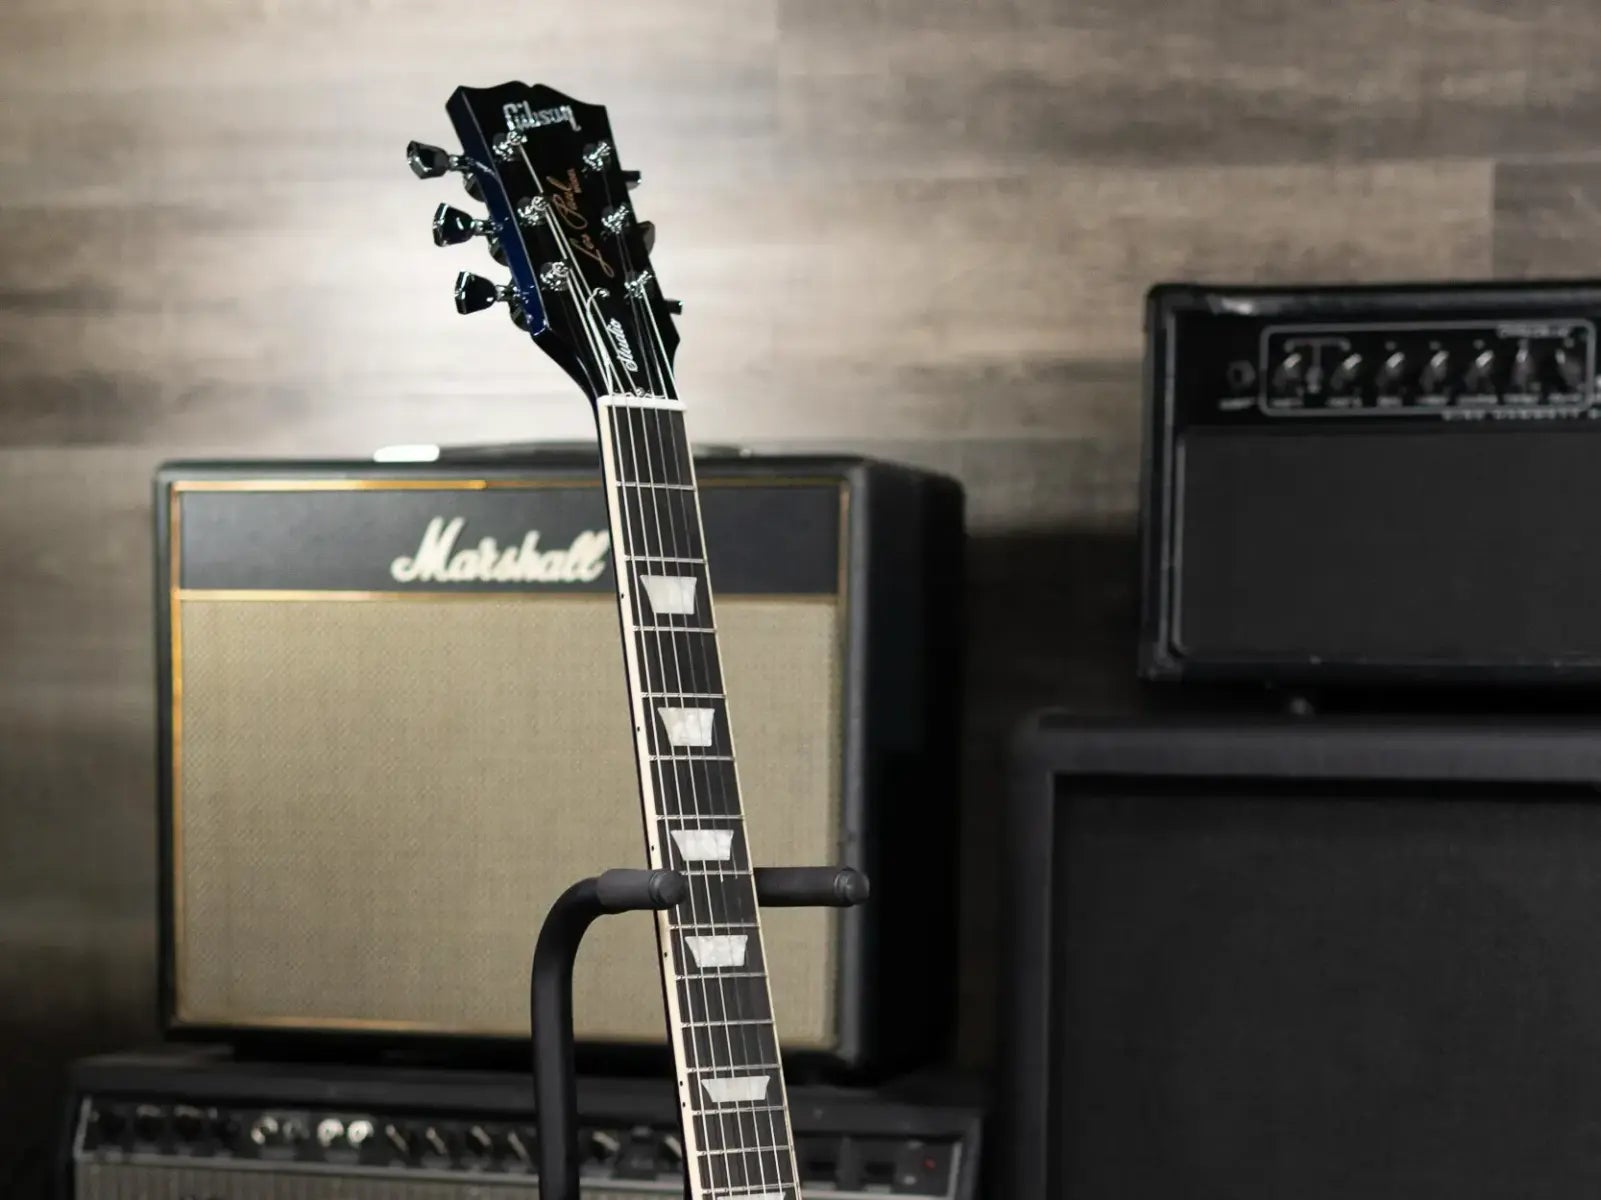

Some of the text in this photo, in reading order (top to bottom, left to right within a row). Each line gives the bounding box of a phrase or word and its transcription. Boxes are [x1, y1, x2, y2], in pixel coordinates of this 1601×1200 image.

[502, 99, 582, 132] Gibson
[606, 317, 639, 373] Studio
[390, 516, 610, 582] Marshall
